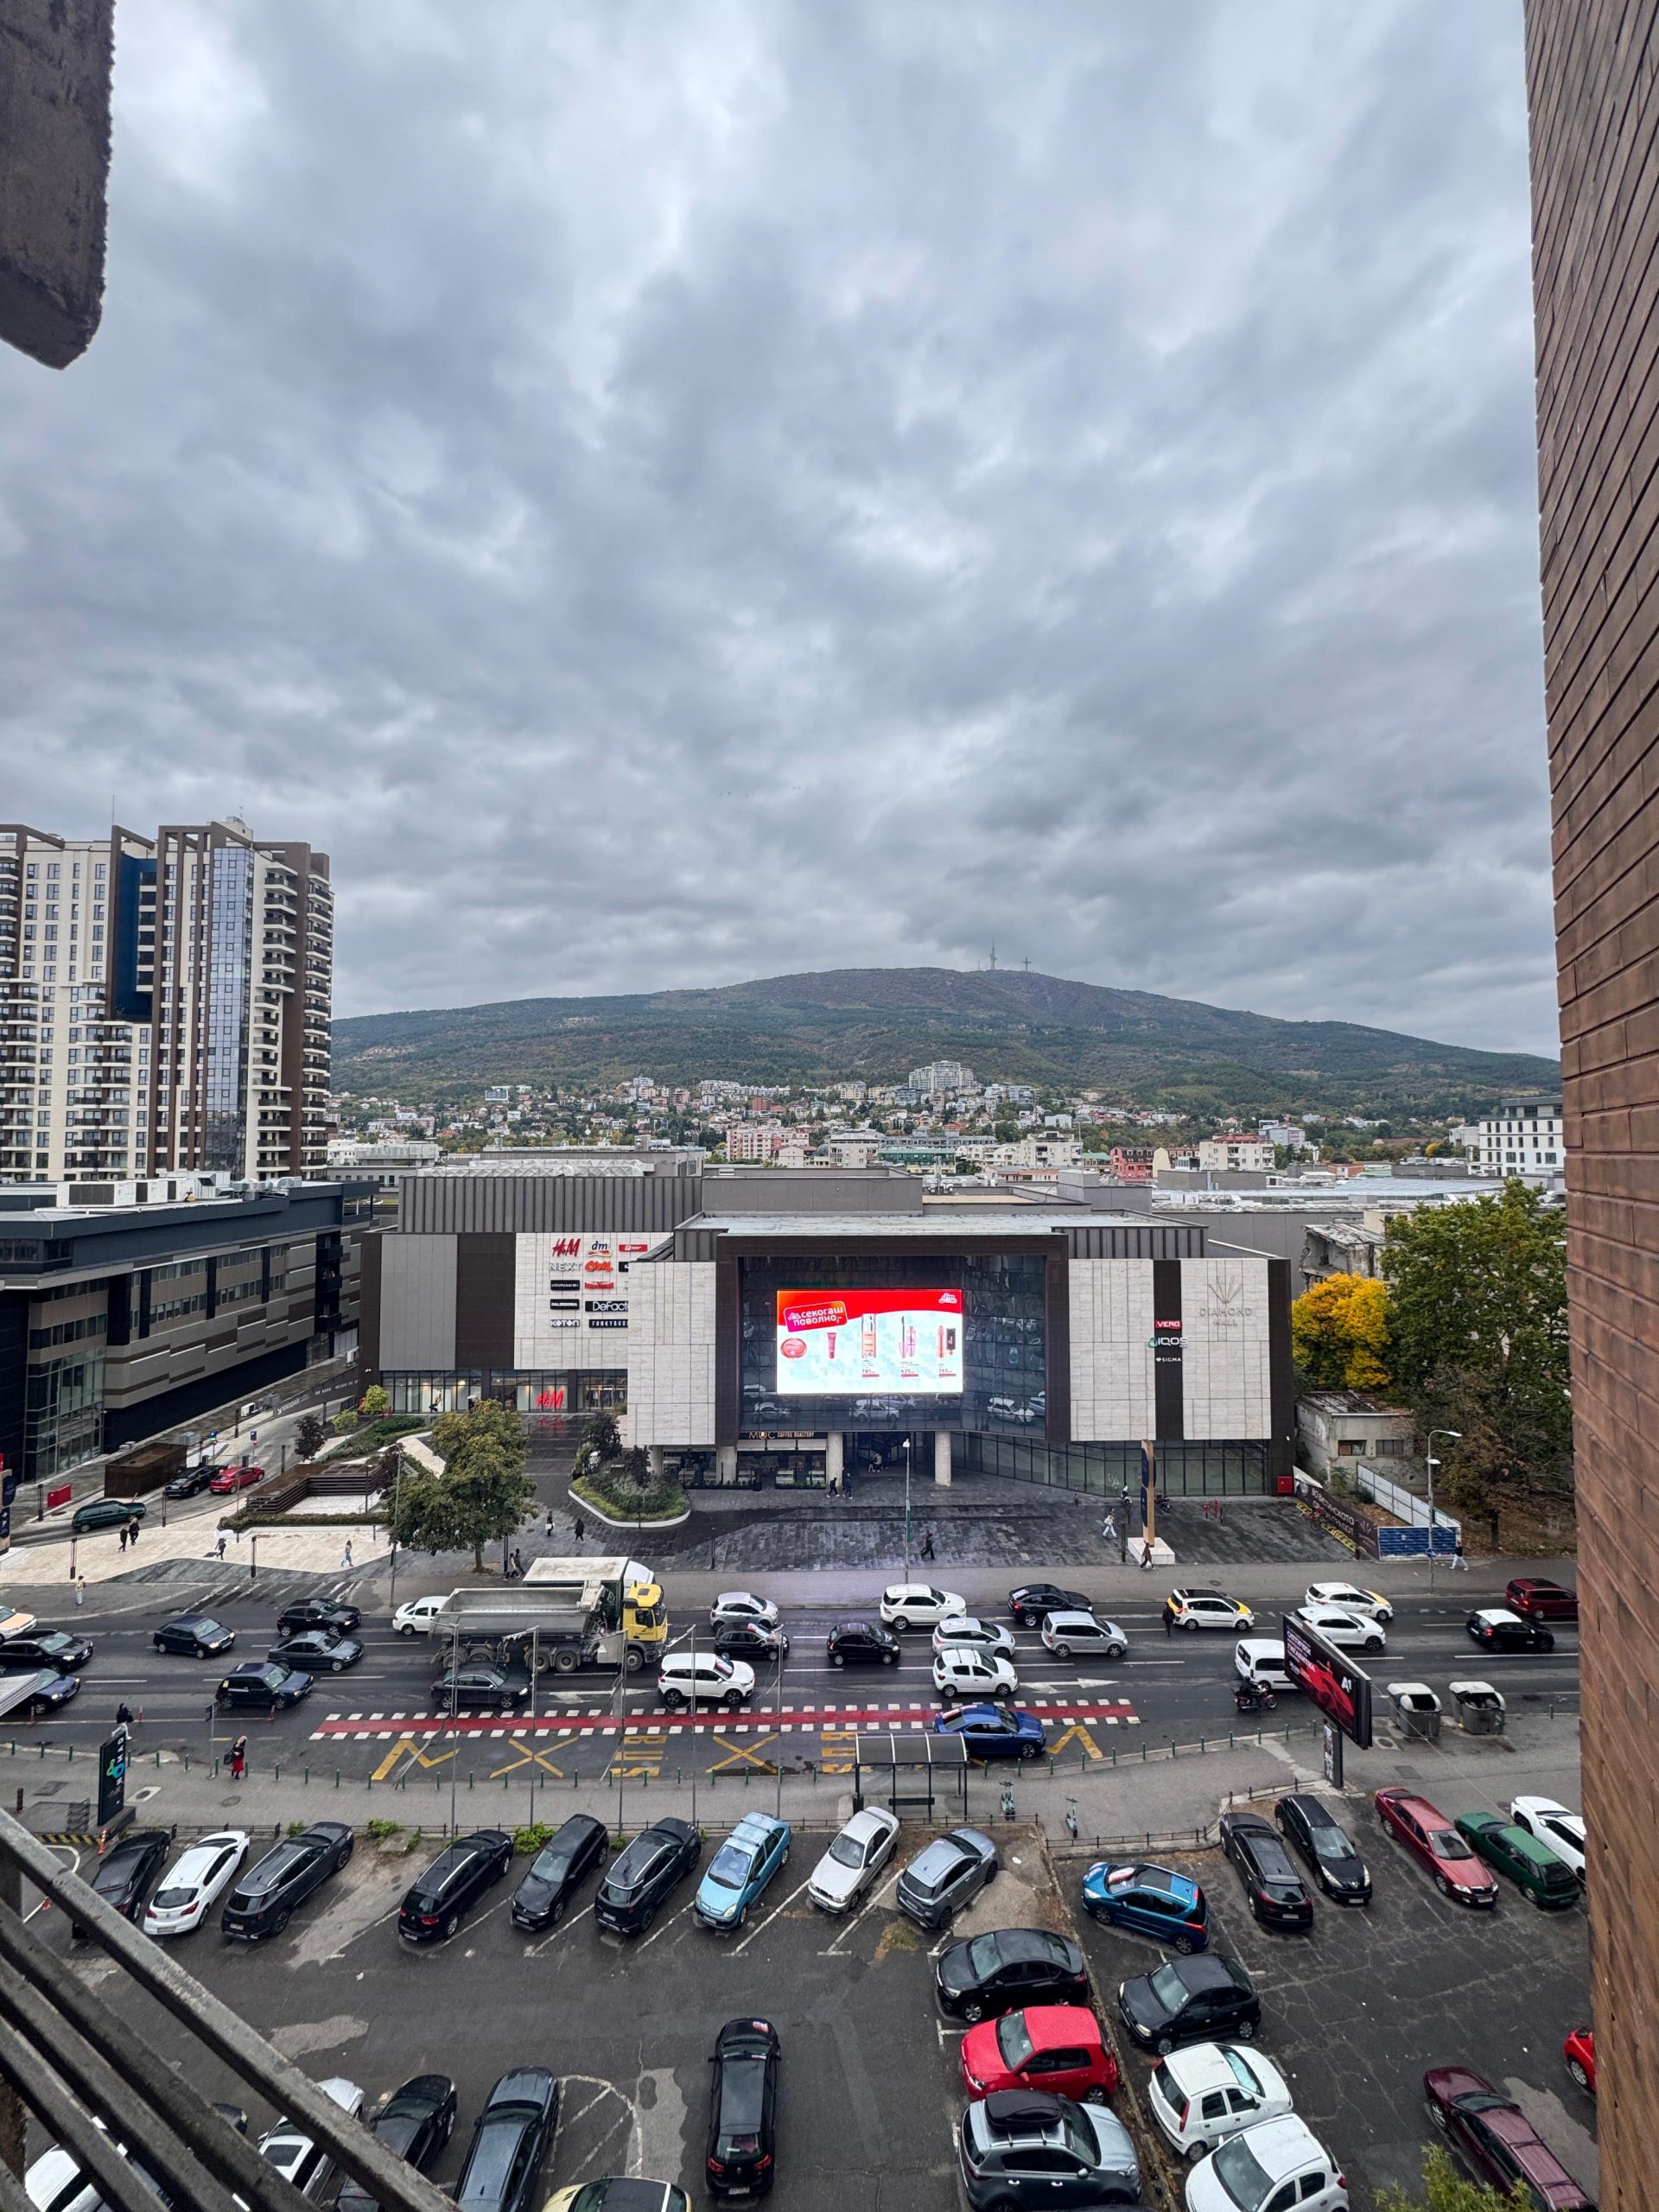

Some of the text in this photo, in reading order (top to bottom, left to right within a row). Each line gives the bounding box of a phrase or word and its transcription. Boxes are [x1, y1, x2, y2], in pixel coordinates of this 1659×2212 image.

[552, 1238, 581, 1257] H&M
[592, 1241, 608, 1250] dm
[550, 1262, 582, 1272] NEXT
[592, 1301, 628, 1312] DeFact
[800, 1306, 843, 1319] секогаш
[1199, 1307, 1252, 1317] DIAMOND
[1158, 1337, 1188, 1346] IQOS
[534, 1389, 563, 1410] H&M
[1341, 1676, 1352, 1694] A1
[609, 1735, 668, 1778] BUS
